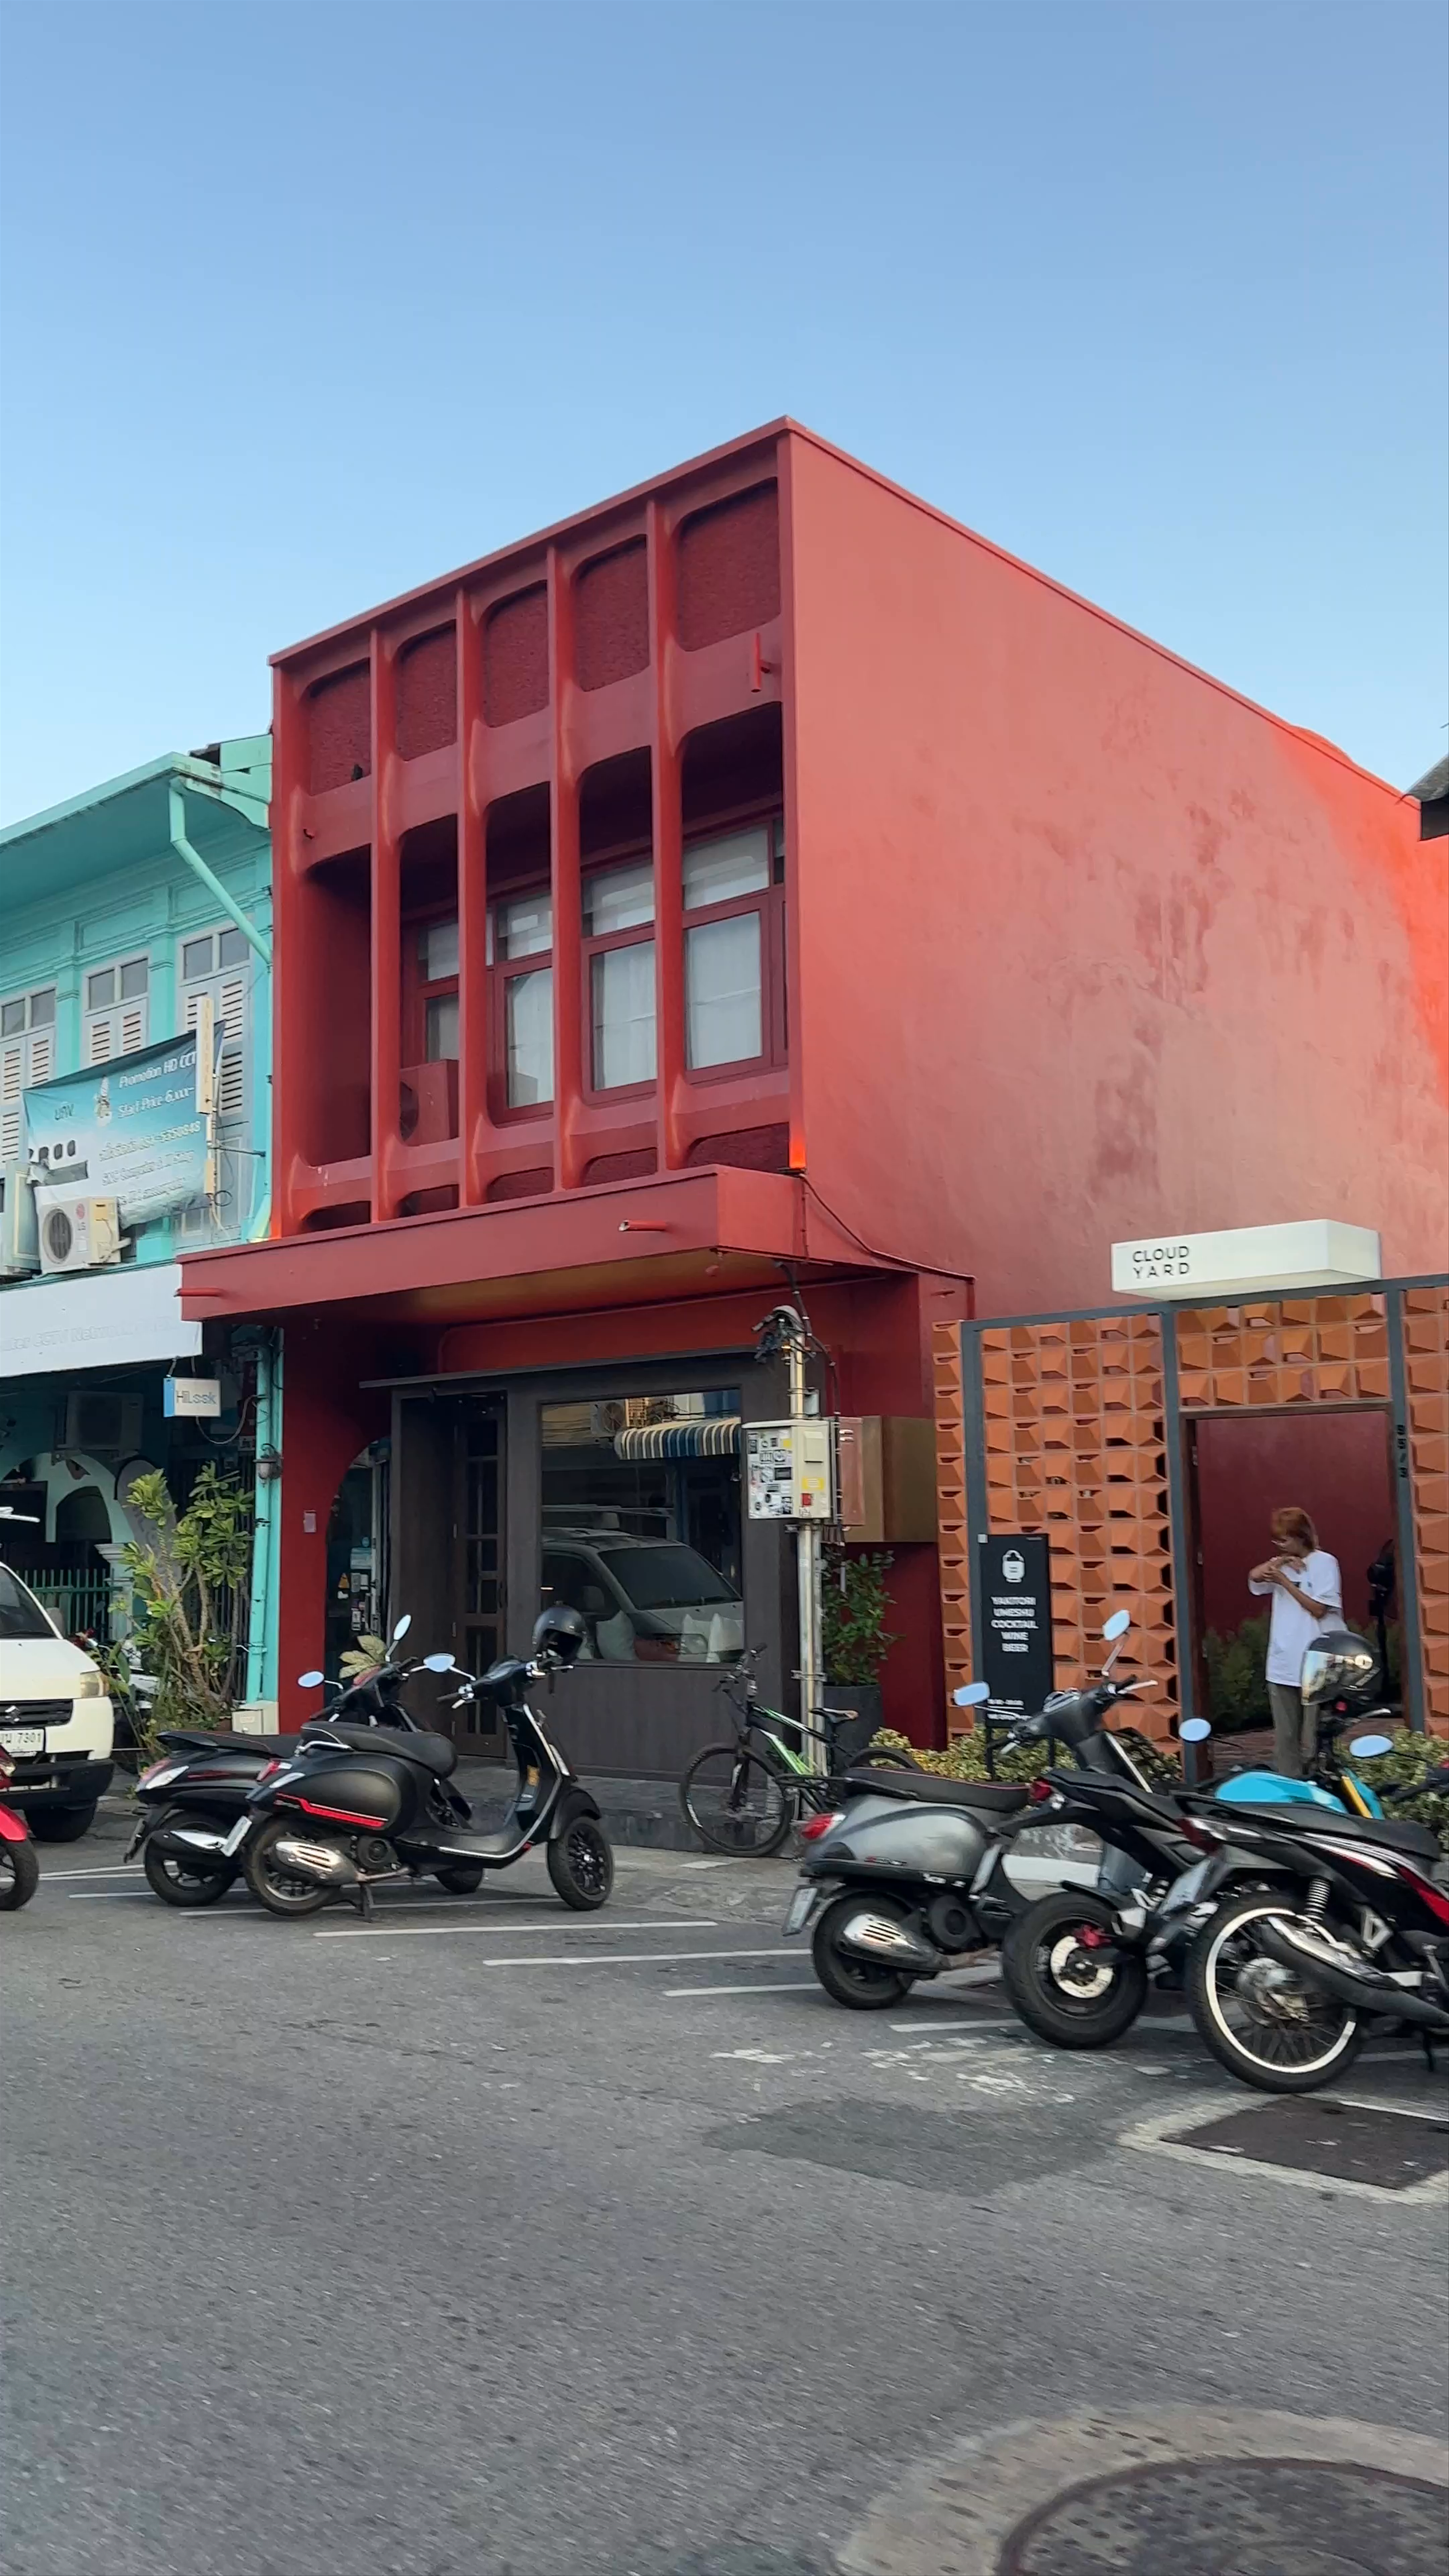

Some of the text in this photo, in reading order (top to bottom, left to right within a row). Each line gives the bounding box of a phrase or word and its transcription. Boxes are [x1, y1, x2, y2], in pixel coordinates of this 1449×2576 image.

[179, 1051, 197, 1069] CCT
[1133, 1246, 1190, 1263] CLOUD
[1133, 1262, 1190, 1279] YARD
[991, 1620, 1039, 1629] COCKTAIL
[1001, 1632, 1029, 1640] WINE
[1001, 1643, 1029, 1653] BEER
